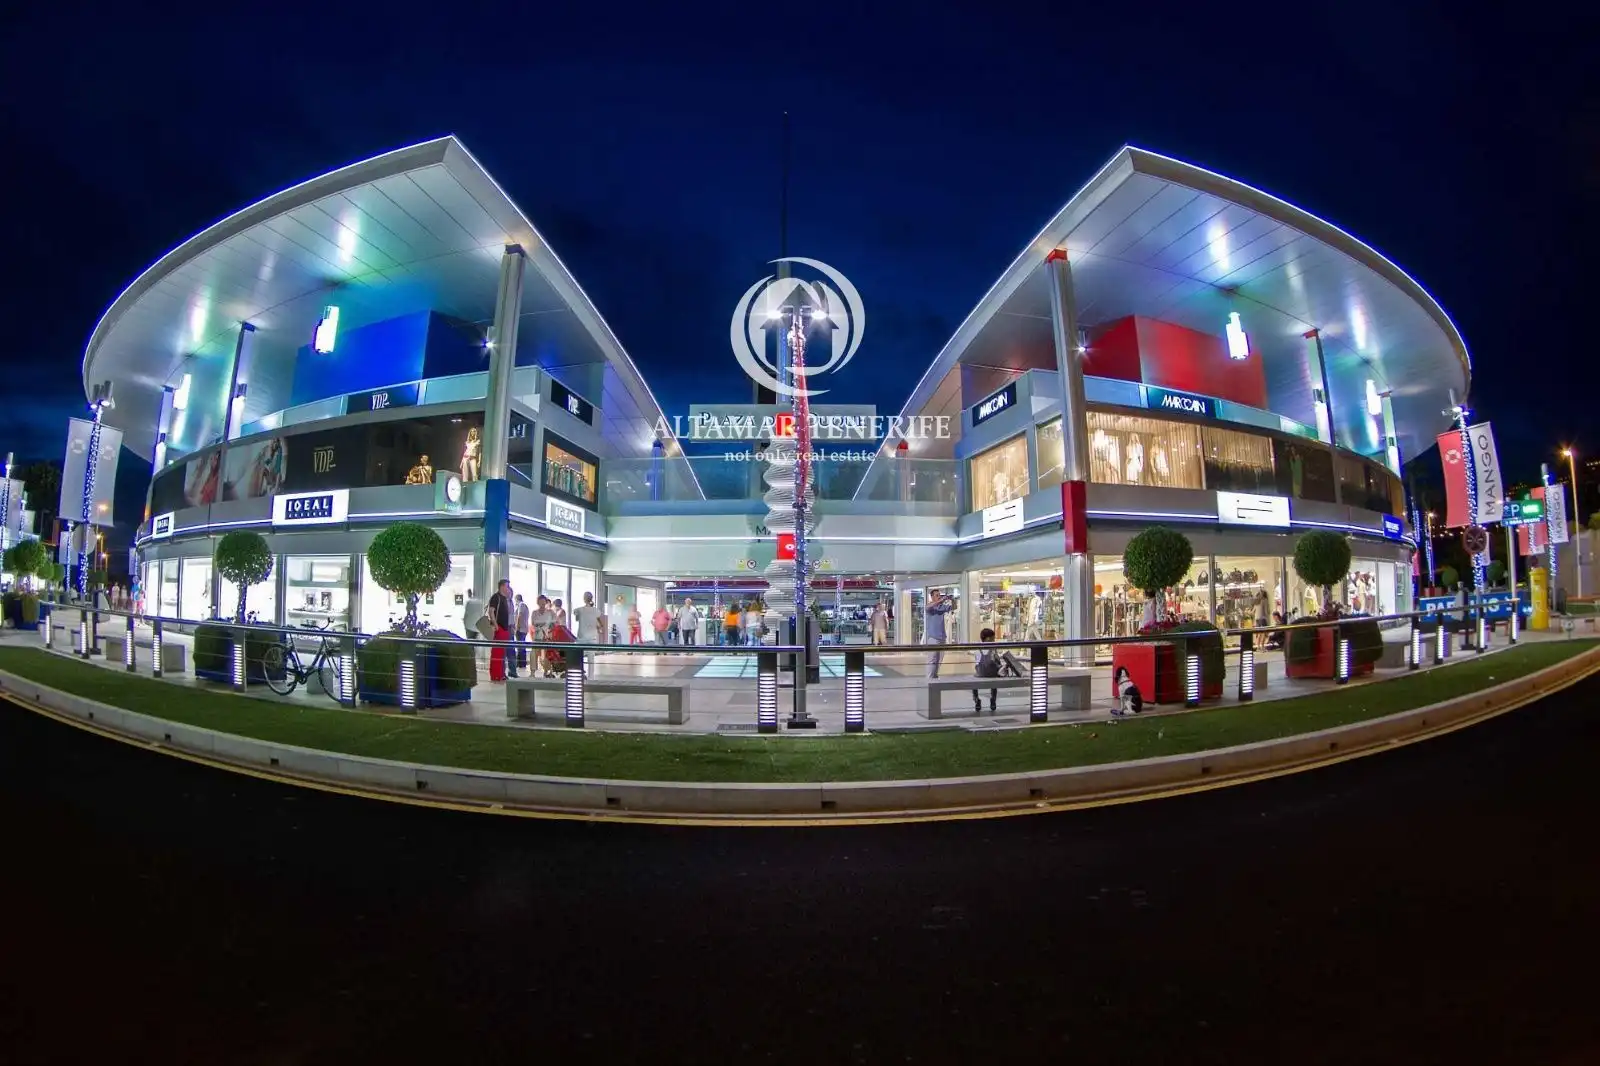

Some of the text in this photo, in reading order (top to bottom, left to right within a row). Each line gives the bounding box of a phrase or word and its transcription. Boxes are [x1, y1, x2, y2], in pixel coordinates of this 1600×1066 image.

[1477, 434, 1496, 516] MANGO
[287, 498, 329, 512] IDEAL
[1425, 597, 1500, 617] PARING
